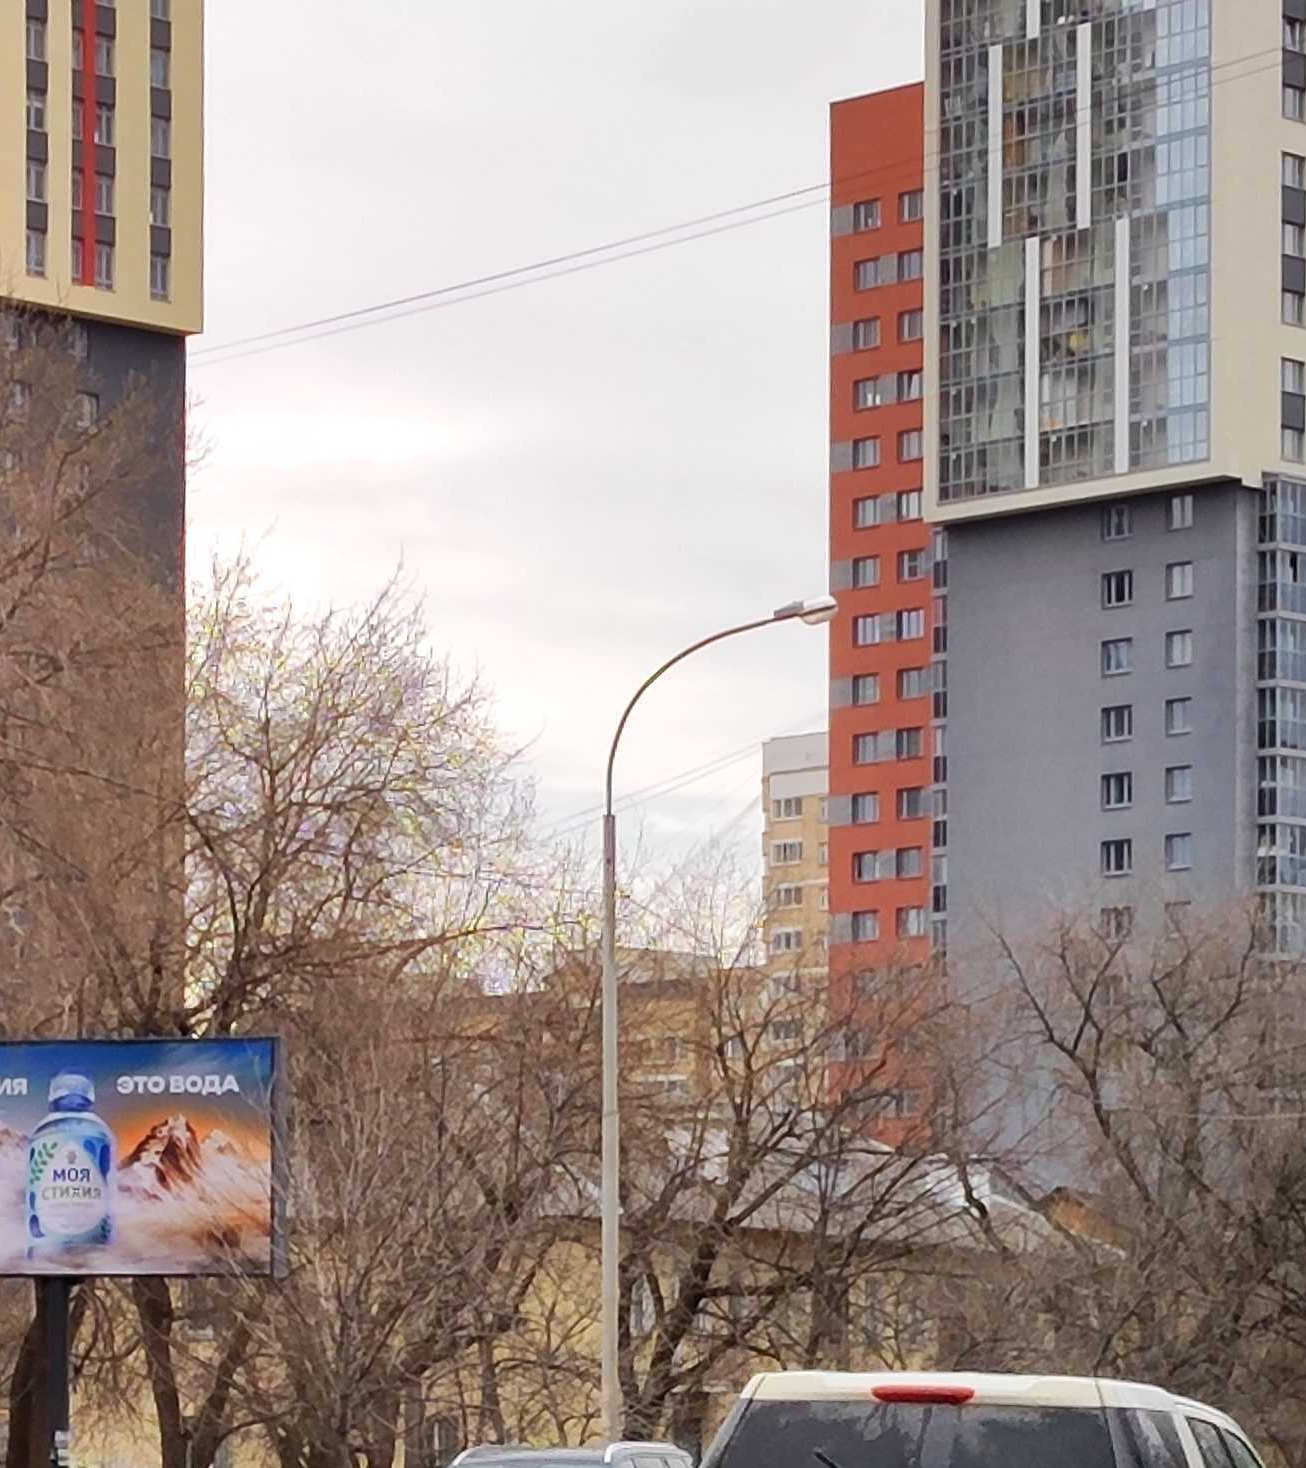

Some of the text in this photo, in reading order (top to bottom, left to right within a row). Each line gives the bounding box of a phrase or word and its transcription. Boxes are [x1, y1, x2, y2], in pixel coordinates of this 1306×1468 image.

[116, 1075, 240, 1096] ЭТО ВОДА
[53, 1167, 91, 1182] МОЯ
